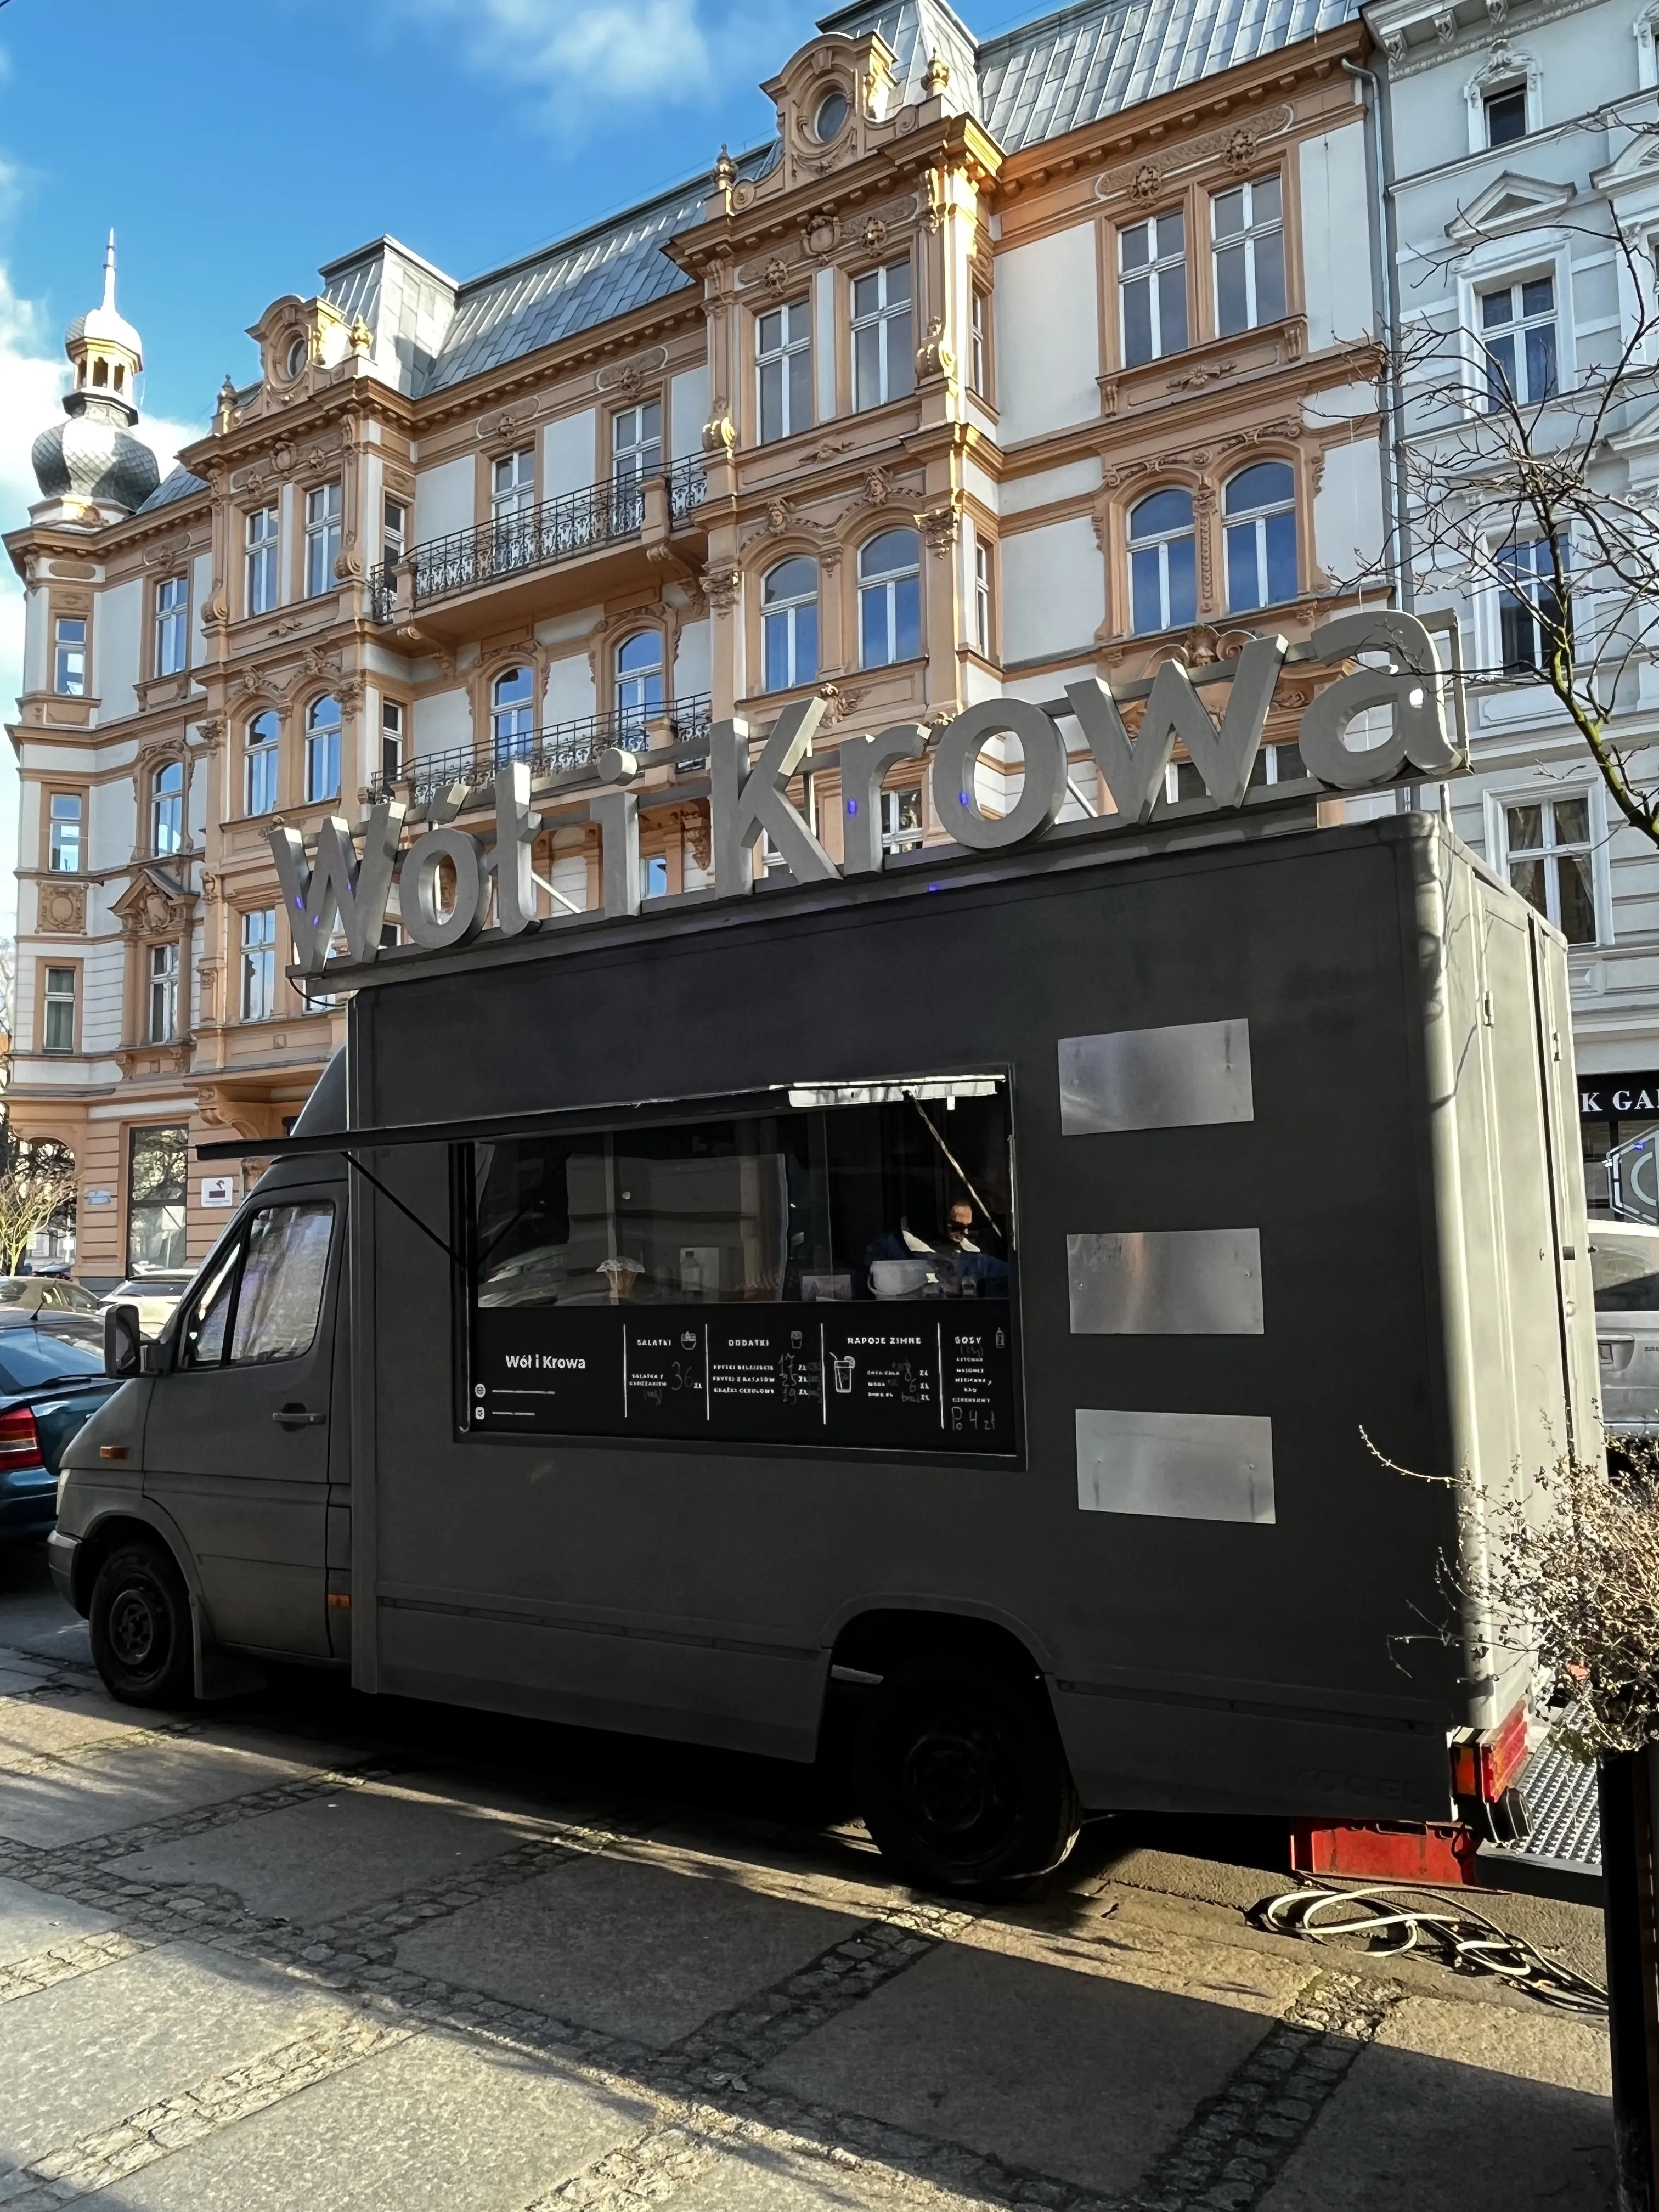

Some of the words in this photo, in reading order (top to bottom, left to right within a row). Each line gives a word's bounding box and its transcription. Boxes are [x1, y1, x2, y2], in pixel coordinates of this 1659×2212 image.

[268, 762, 543, 979] Wół
[590, 747, 641, 918] i
[710, 609, 1472, 899] Krowa
[1612, 1089, 1659, 1110] GA
[506, 1355, 532, 1368] Wół
[535, 1354, 539, 1368] i
[543, 1356, 586, 1369] Krowa
[969, 1410, 978, 1429] 4
